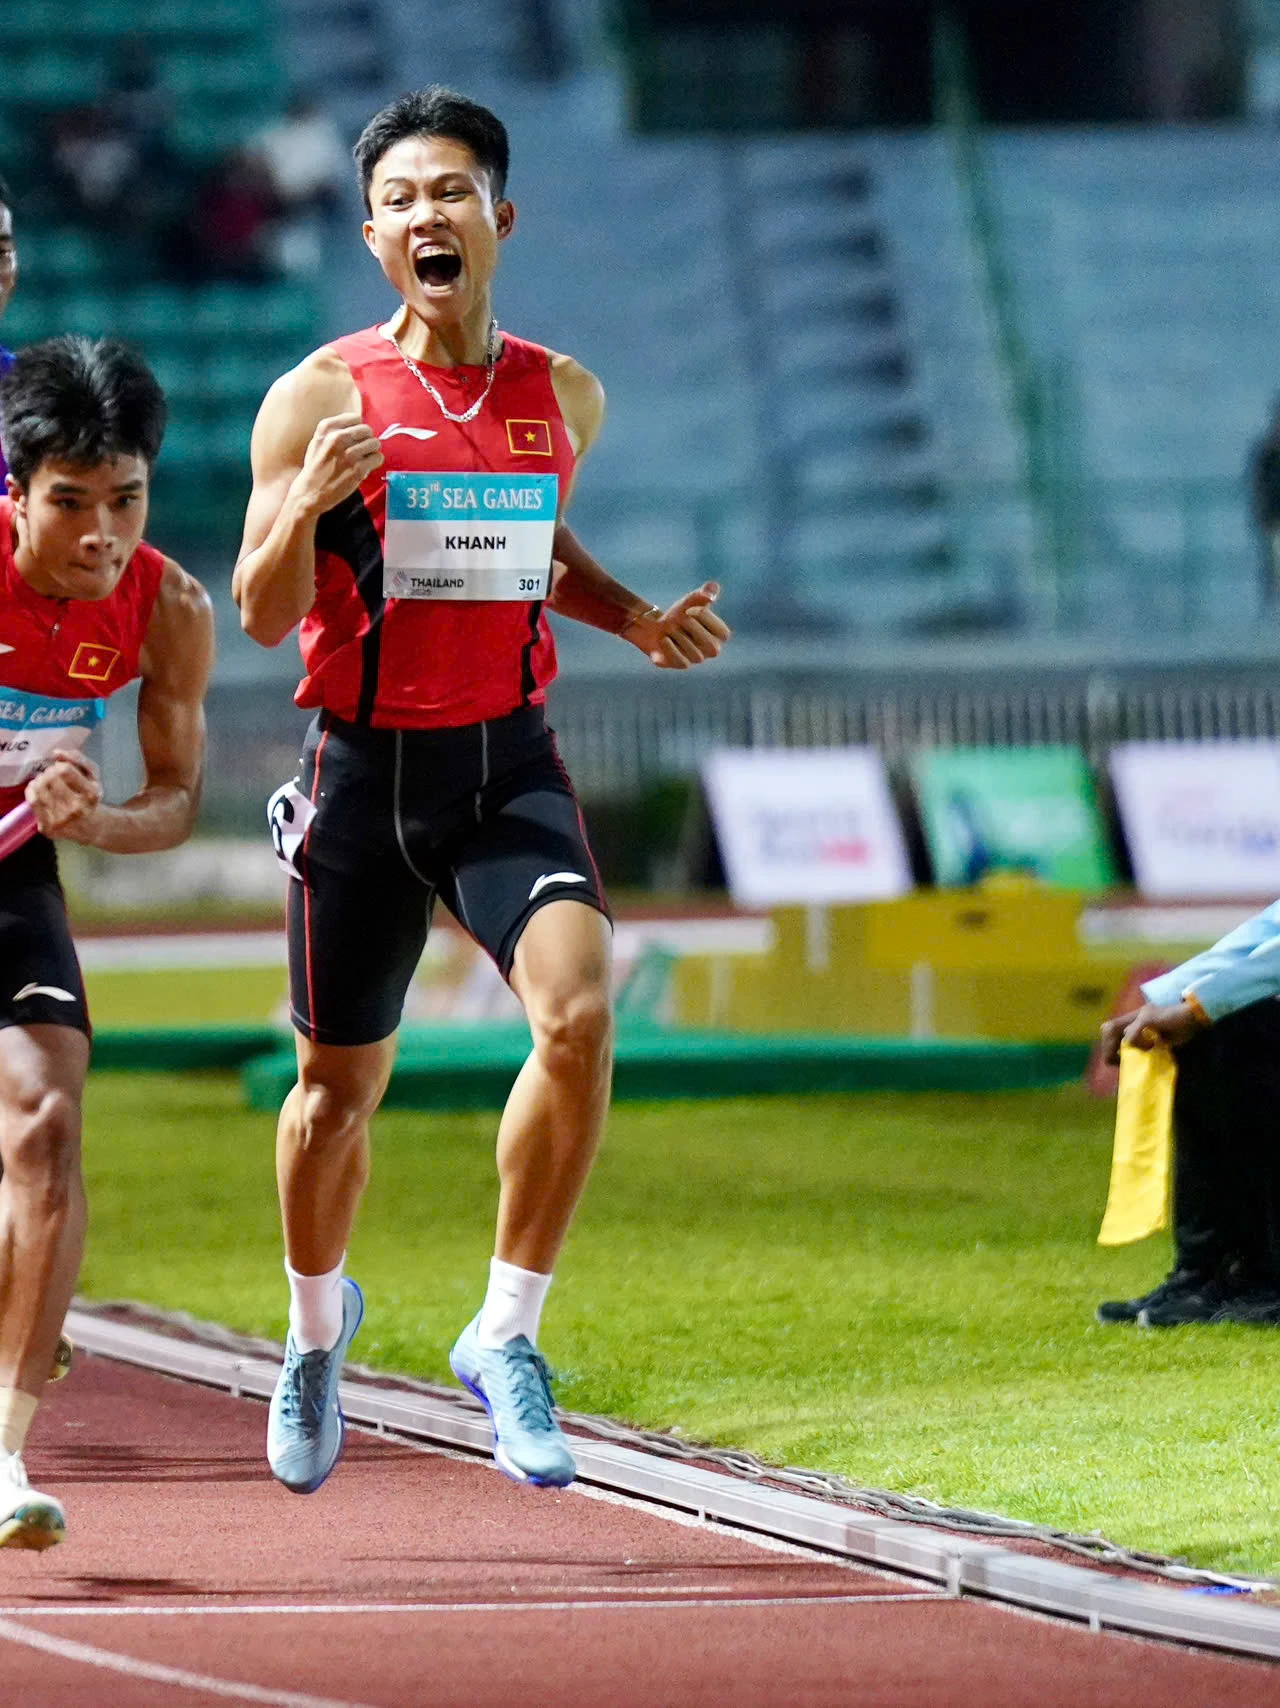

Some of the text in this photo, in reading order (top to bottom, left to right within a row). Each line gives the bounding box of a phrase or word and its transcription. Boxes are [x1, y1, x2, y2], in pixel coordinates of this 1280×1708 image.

[442, 487, 478, 510] SEA
[483, 487, 544, 510] GAMES
[445, 536, 507, 550] KHANH
[410, 577, 540, 591] THAILAND 301
[30, 706, 89, 723] GAMES
